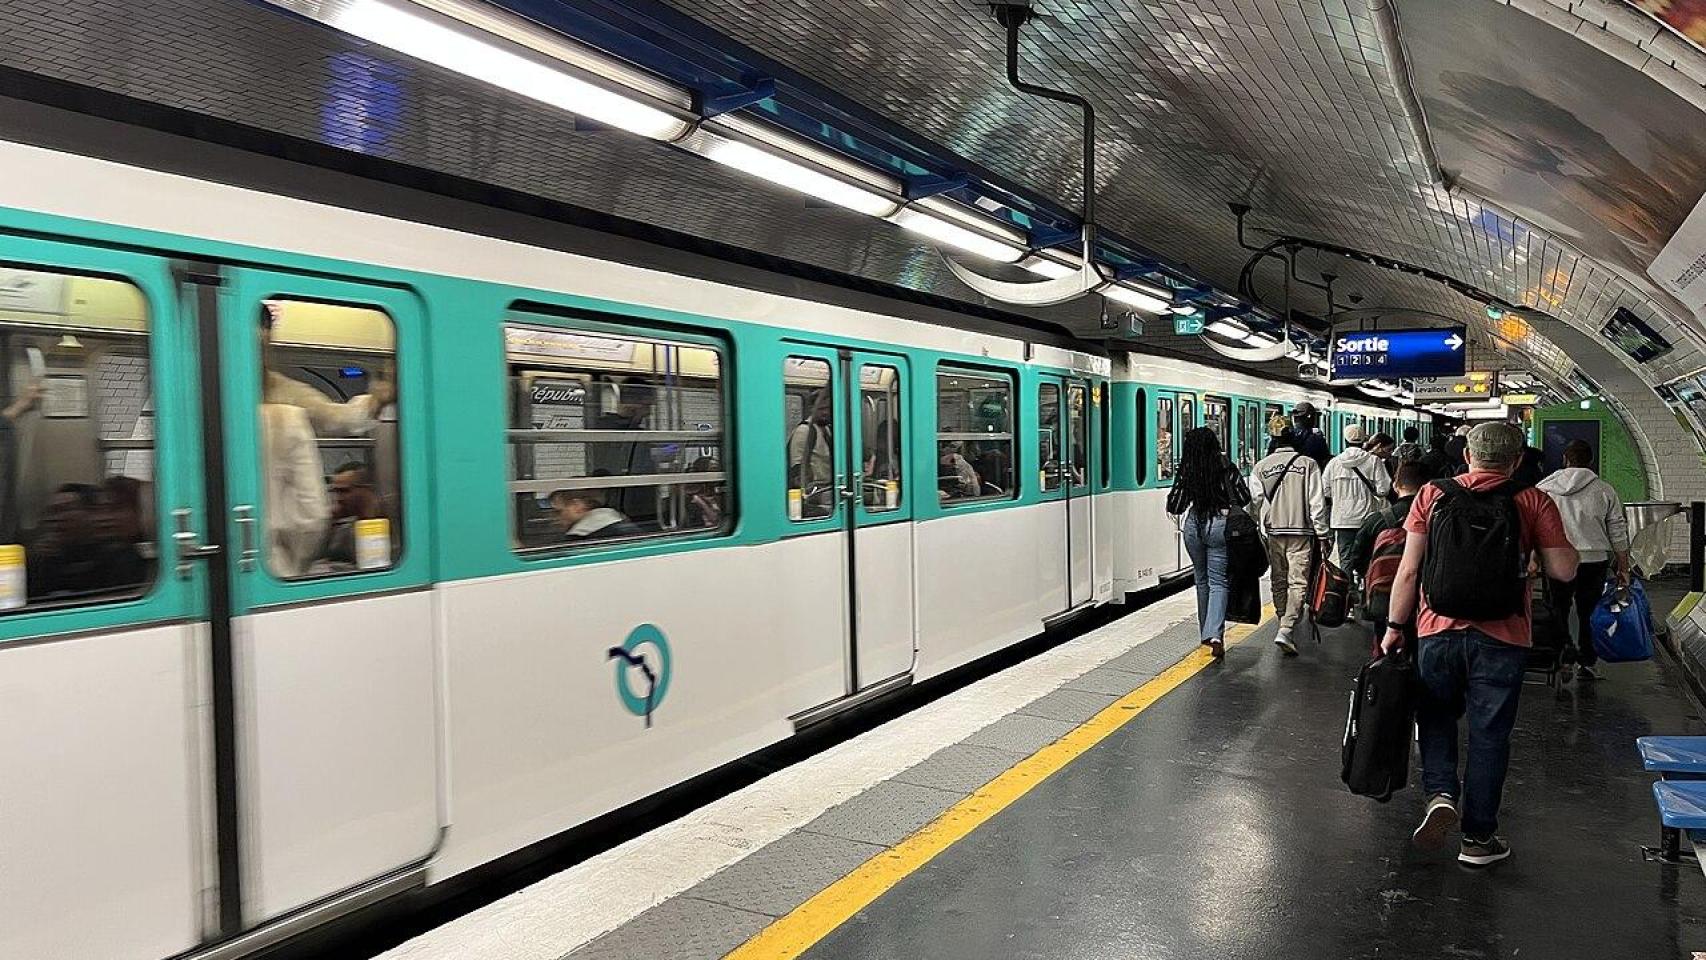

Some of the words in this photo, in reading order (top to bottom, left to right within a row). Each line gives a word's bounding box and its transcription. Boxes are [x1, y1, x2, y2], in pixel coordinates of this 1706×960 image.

[1336, 337, 1389, 352] Sortie
[1352, 356, 1359, 365] 2
[1365, 355, 1371, 365] 3
[1377, 355, 1384, 364] 4
